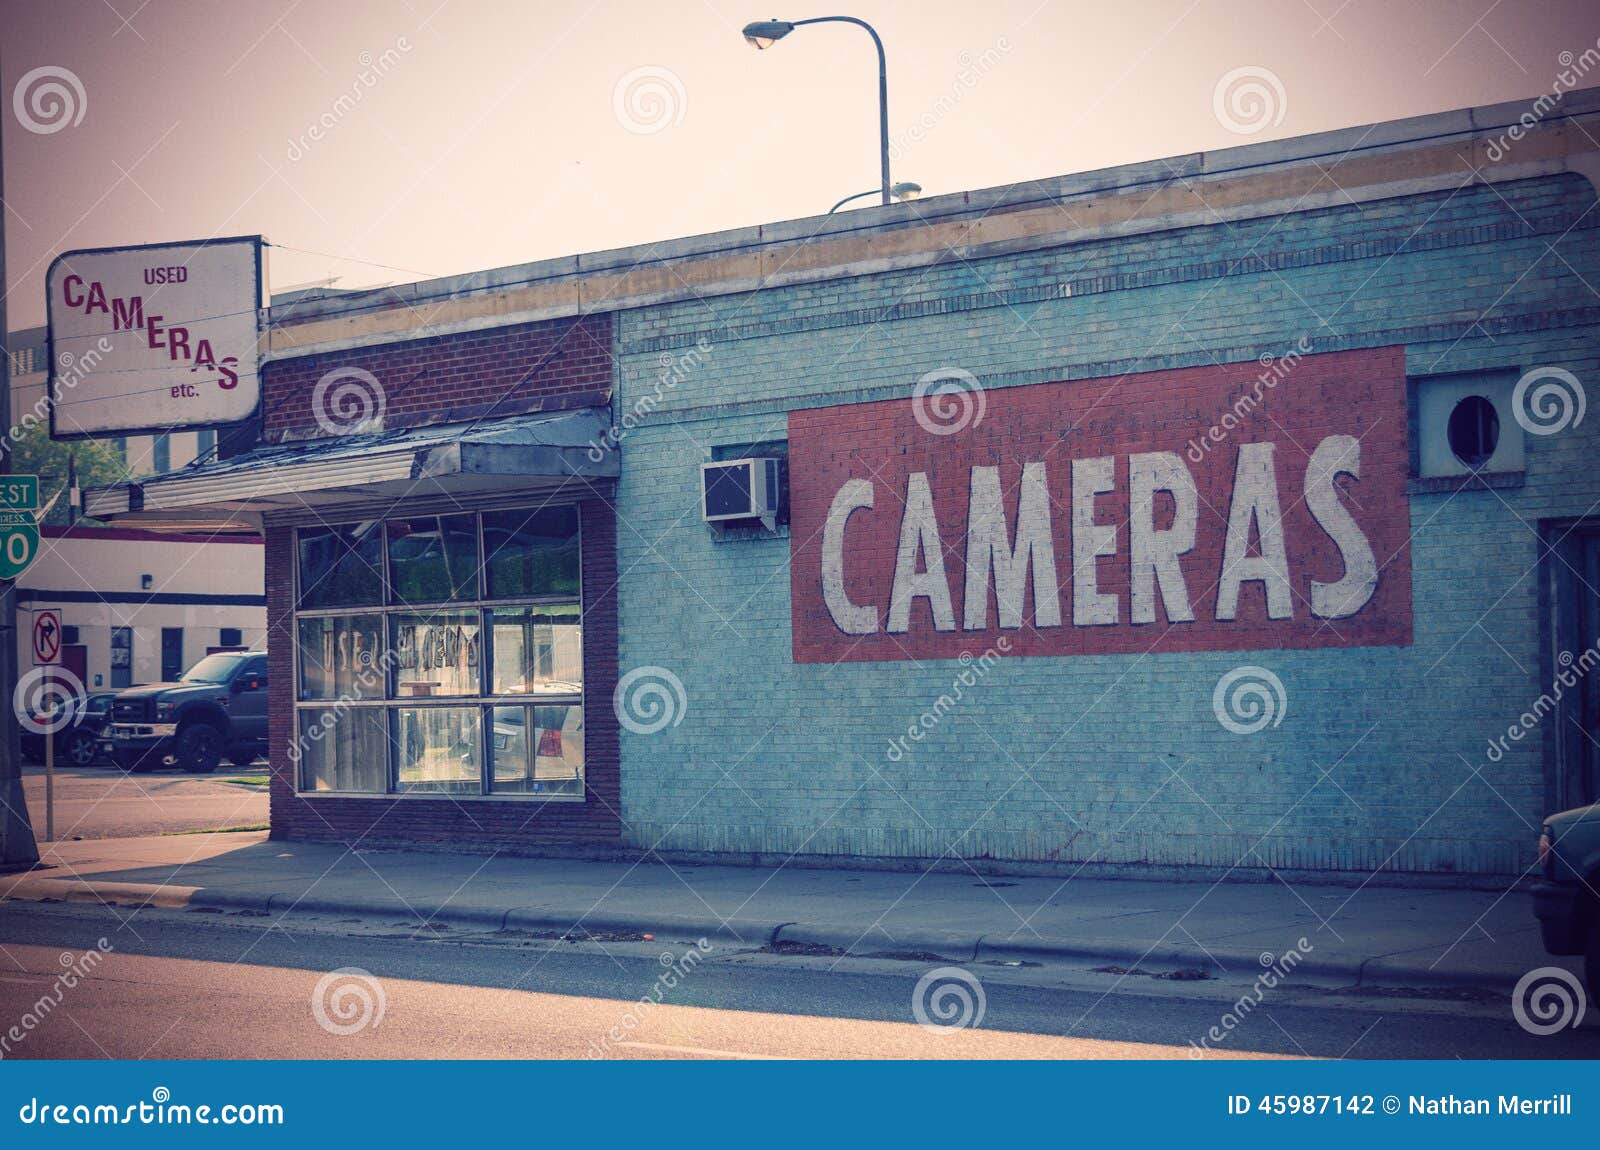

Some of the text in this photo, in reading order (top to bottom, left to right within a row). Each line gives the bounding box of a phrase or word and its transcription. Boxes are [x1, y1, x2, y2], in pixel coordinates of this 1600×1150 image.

[144, 266, 188, 285] USED
[62, 274, 239, 390] CAMERAS
[170, 383, 200, 398] etc.
[0, 533, 29, 565] 0
[820, 434, 1378, 635] CAMERAS
